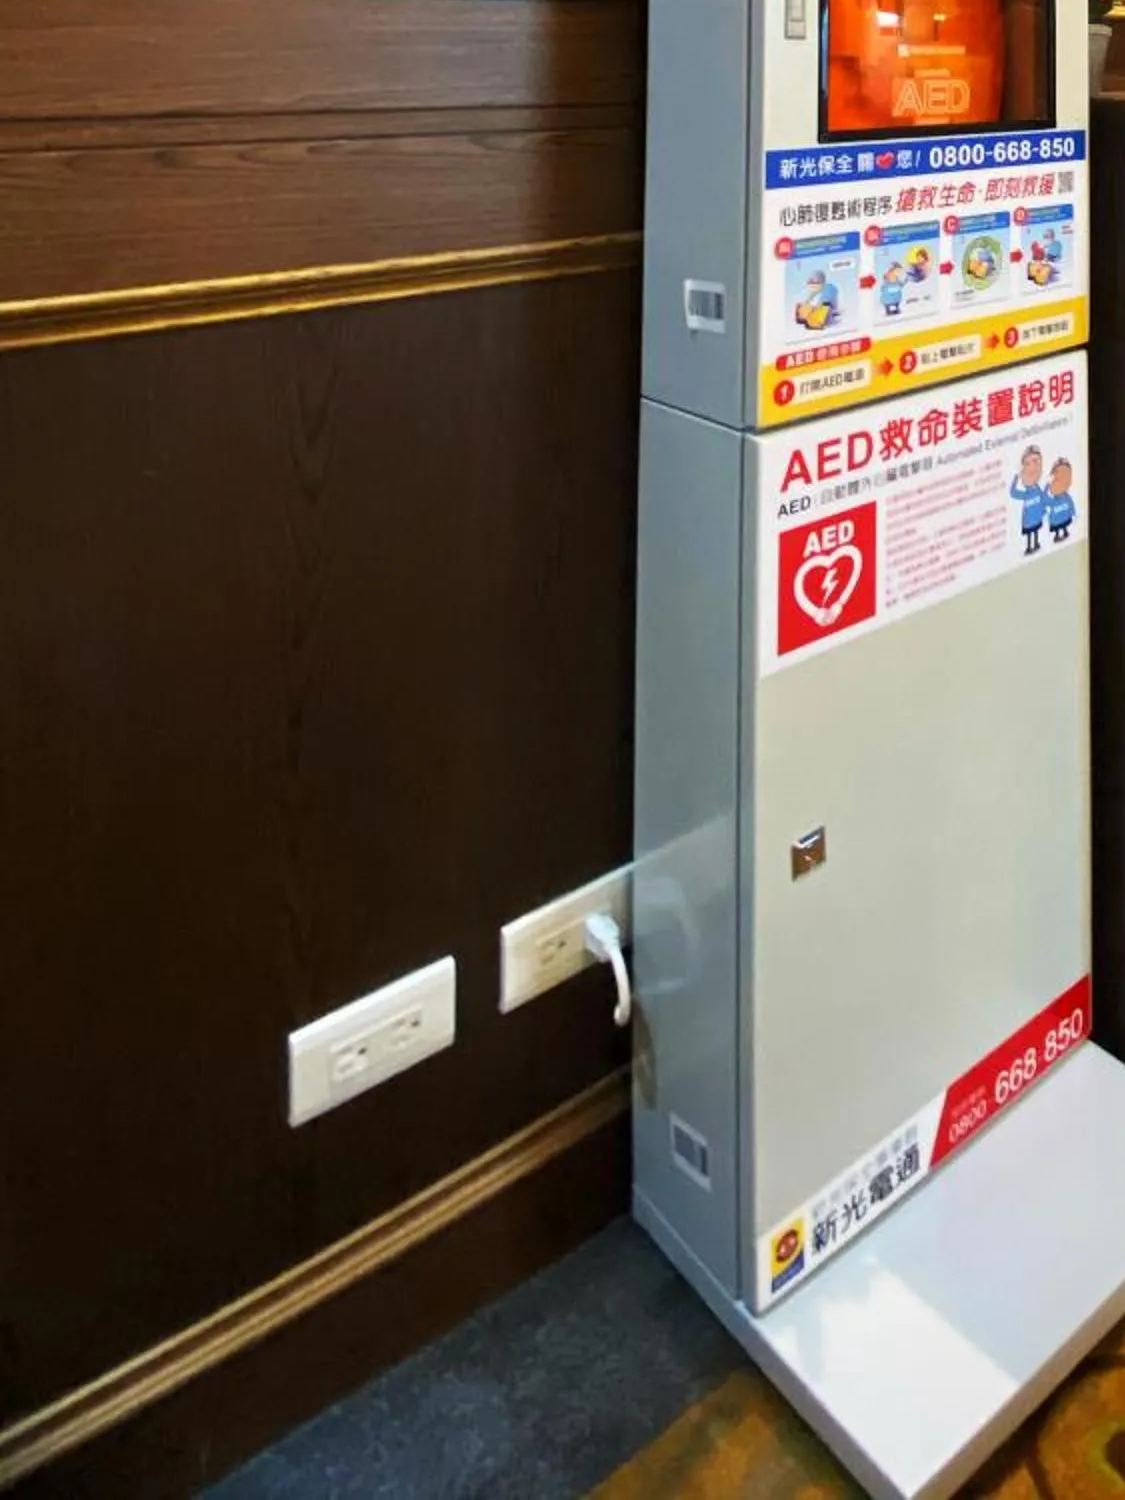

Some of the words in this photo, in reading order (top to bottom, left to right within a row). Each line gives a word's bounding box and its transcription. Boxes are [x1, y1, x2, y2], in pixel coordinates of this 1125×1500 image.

[892, 79, 970, 117] AED
[929, 137, 1075, 169] 0800-668-850
[803, 521, 854, 558] AED
[995, 1047, 1037, 1104] 668
[1044, 1008, 1083, 1062] 850
